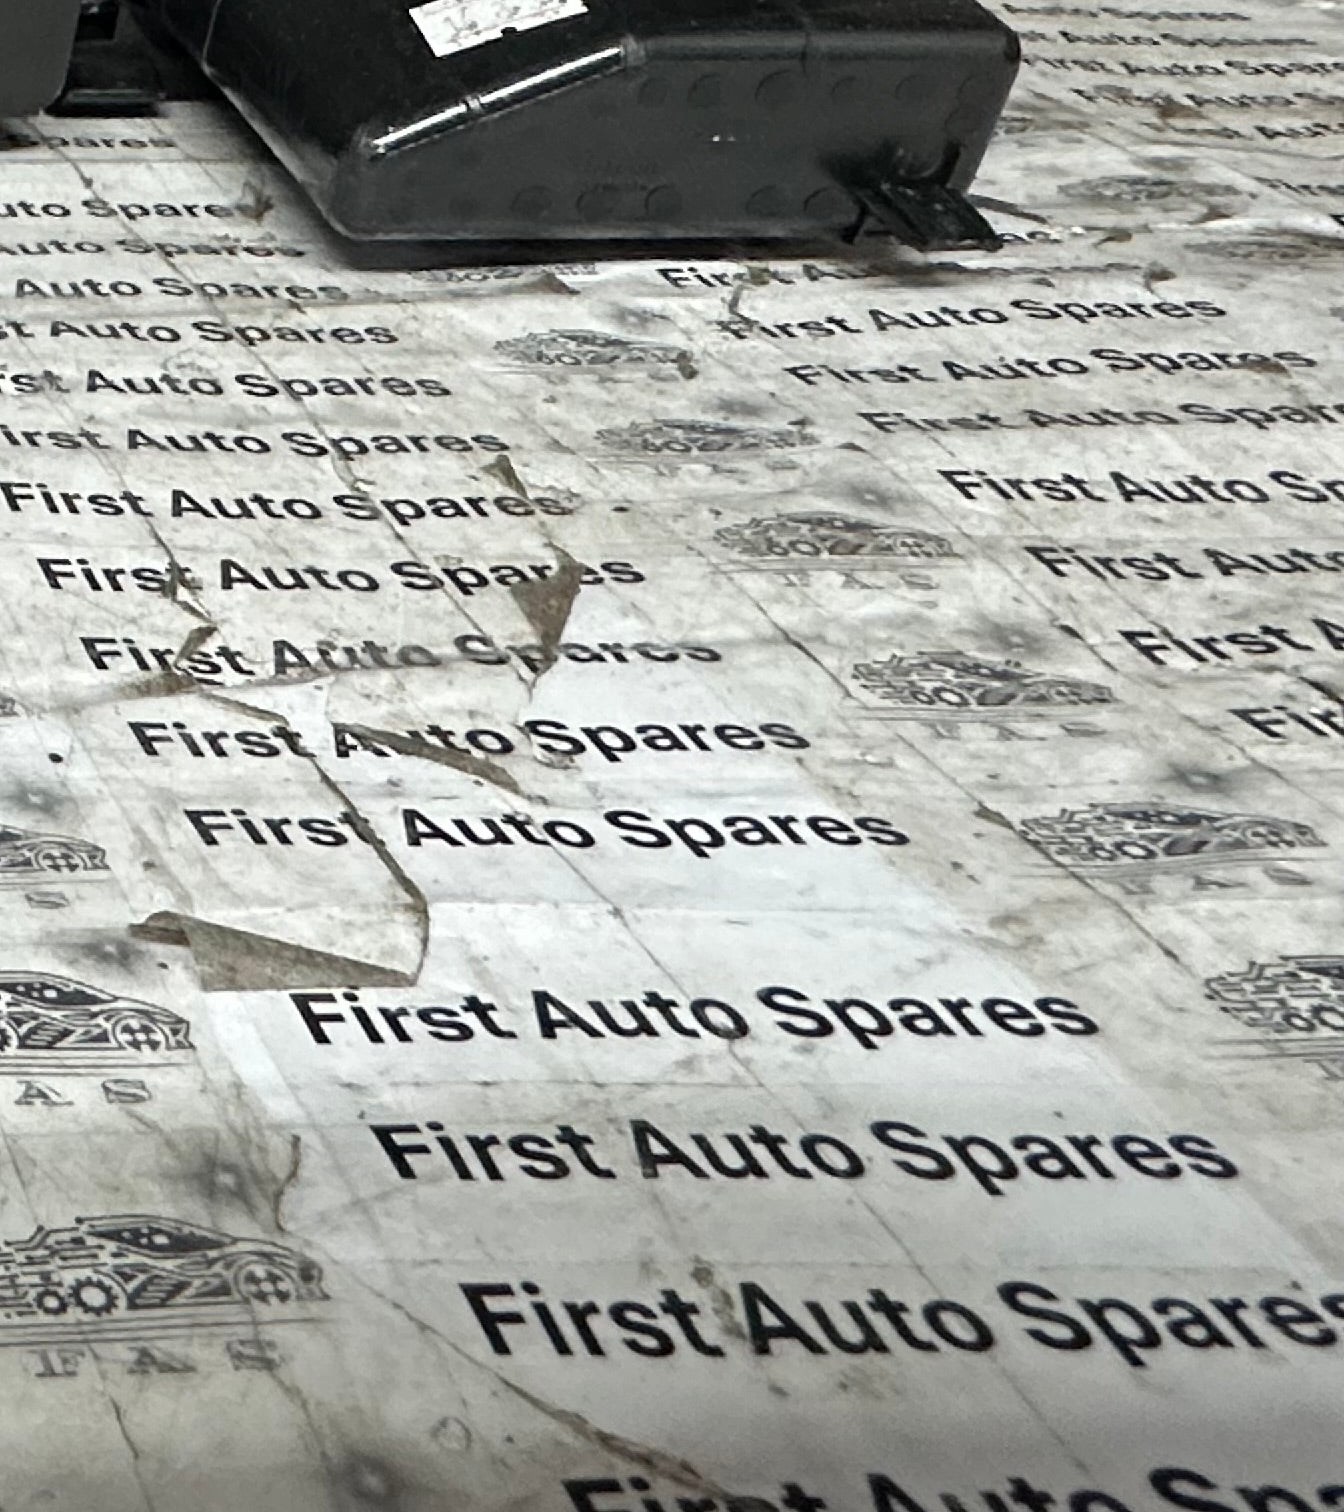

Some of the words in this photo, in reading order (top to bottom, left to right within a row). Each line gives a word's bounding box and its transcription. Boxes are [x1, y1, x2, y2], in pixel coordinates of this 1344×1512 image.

[869, 306, 1007, 332] Auto
[1011, 298, 1228, 325] Spares
[785, 364, 937, 387] First
[942, 357, 1088, 384] Auto
[126, 427, 271, 455] Auto
[281, 430, 512, 461] Spares
[170, 488, 323, 521] Auto
[332, 491, 576, 526] Spares
[402, 808, 597, 850] Auto
[602, 808, 911, 858] Spares
[290, 990, 518, 1046] First
[532, 987, 750, 1041] Auto
[753, 985, 1100, 1050] Spares
[369, 1118, 615, 1183] First
[629, 1118, 868, 1183] Auto
[868, 1116, 1241, 1196] Spares
[460, 1279, 727, 1359] First
[736, 1280, 998, 1360] Auto
